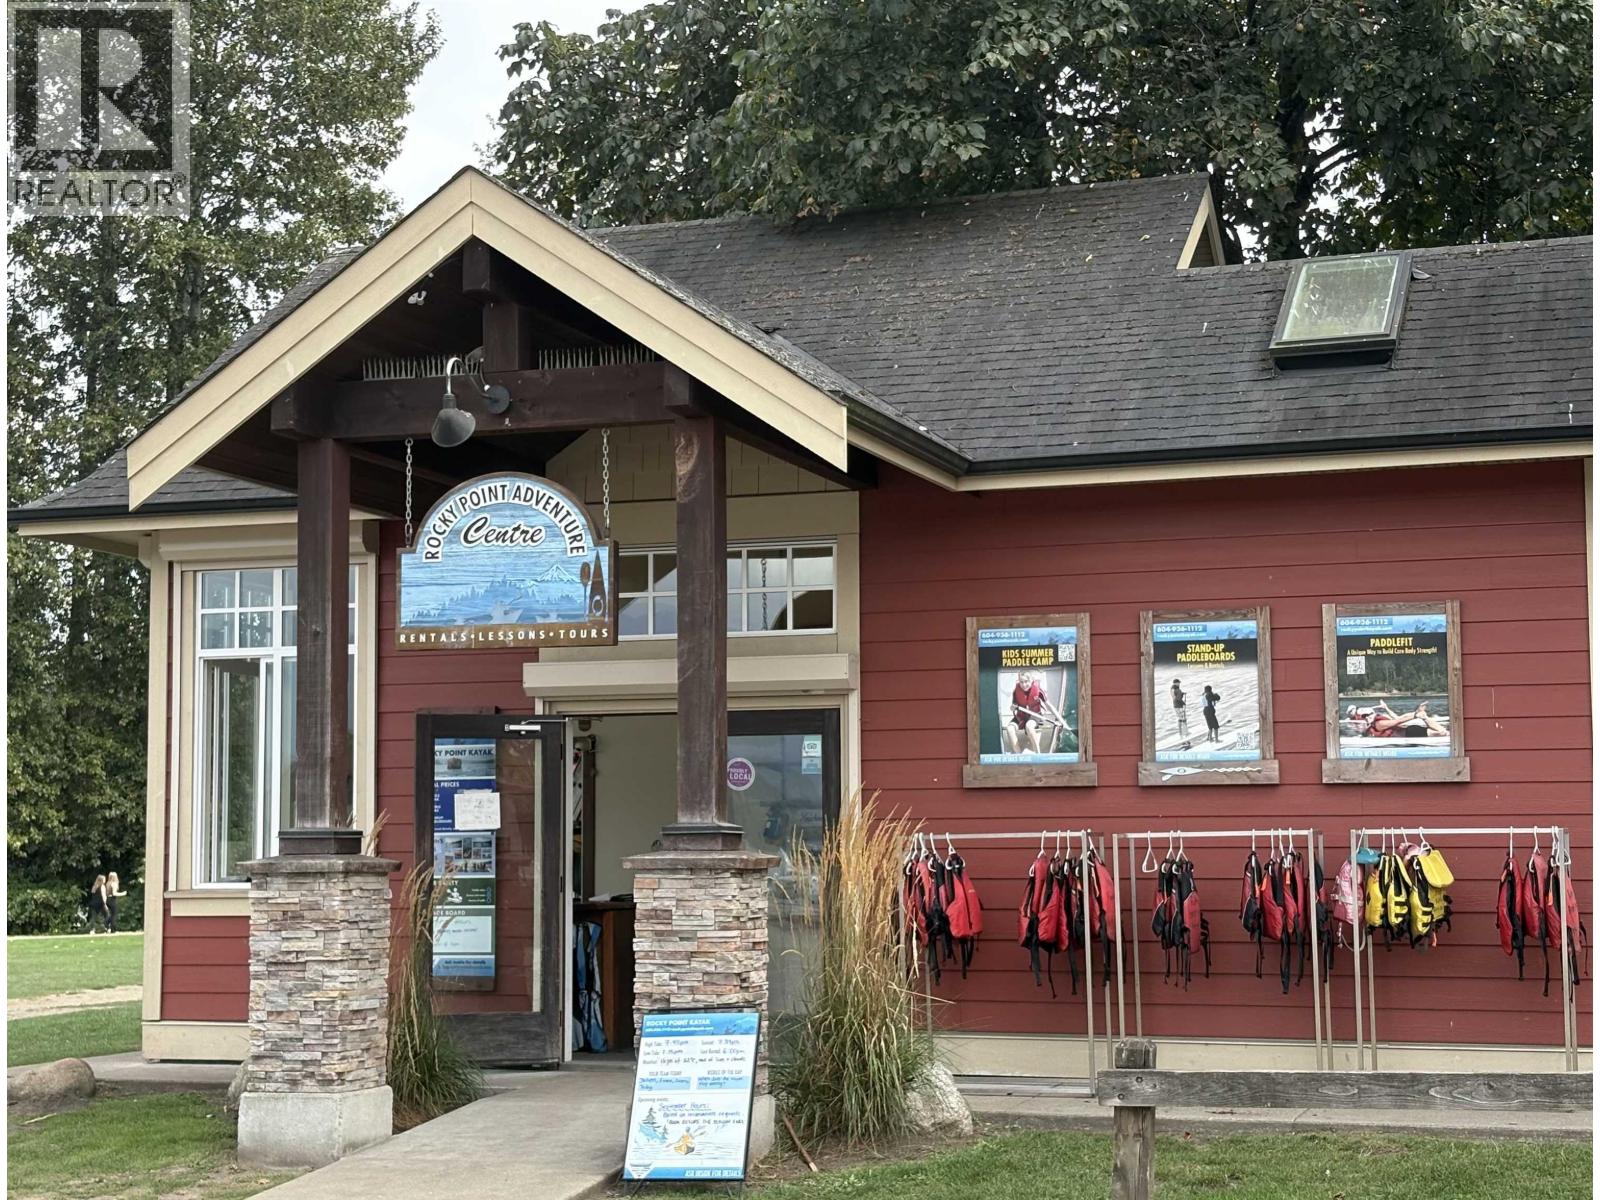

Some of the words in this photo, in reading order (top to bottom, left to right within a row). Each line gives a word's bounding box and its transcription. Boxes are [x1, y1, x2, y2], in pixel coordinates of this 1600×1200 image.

[424, 504, 459, 561] ROCKY
[460, 484, 509, 512] POINT
[512, 484, 586, 555] ADVENTURE
[463, 516, 544, 545] Centre
[400, 632, 467, 644] RENTALS
[478, 630, 545, 642] LESSONS
[559, 628, 609, 640] TOURS
[1370, 637, 1413, 647] PADDLEFIT
[1002, 649, 1019, 658] KIDS
[1021, 648, 1054, 657] SUMMER
[1187, 643, 1225, 653] STAND-UP
[1002, 657, 1030, 666] PADDLE
[1032, 657, 1054, 666] CAMP
[1177, 652, 1236, 662] PADDLEBOARDS
[444, 749, 467, 757] POINT
[468, 748, 493, 756] KAYAK
